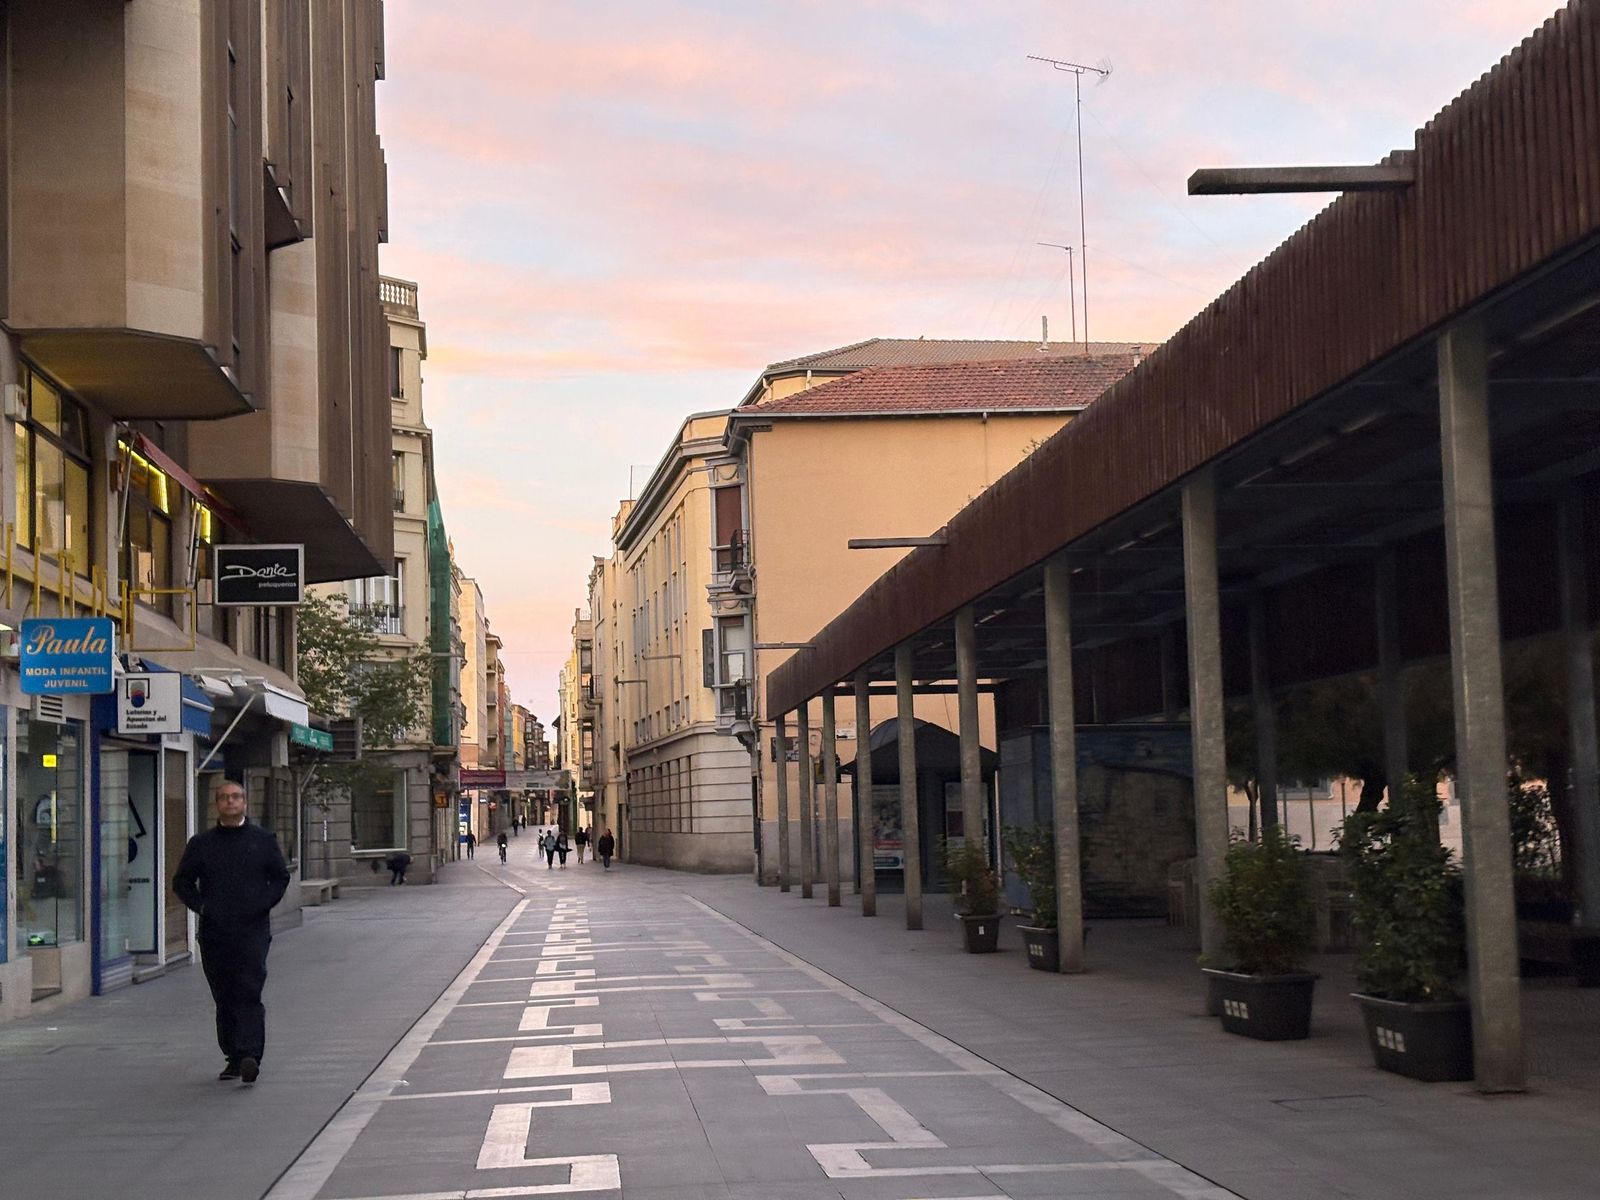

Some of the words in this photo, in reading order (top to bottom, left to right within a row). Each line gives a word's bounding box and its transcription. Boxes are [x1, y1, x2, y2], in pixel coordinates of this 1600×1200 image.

[220, 562, 297, 581] Dania
[26, 625, 107, 655] Paula
[26, 667, 57, 676] MODA
[60, 666, 108, 675] INFANTIL
[44, 680, 89, 688] JUVENIL
